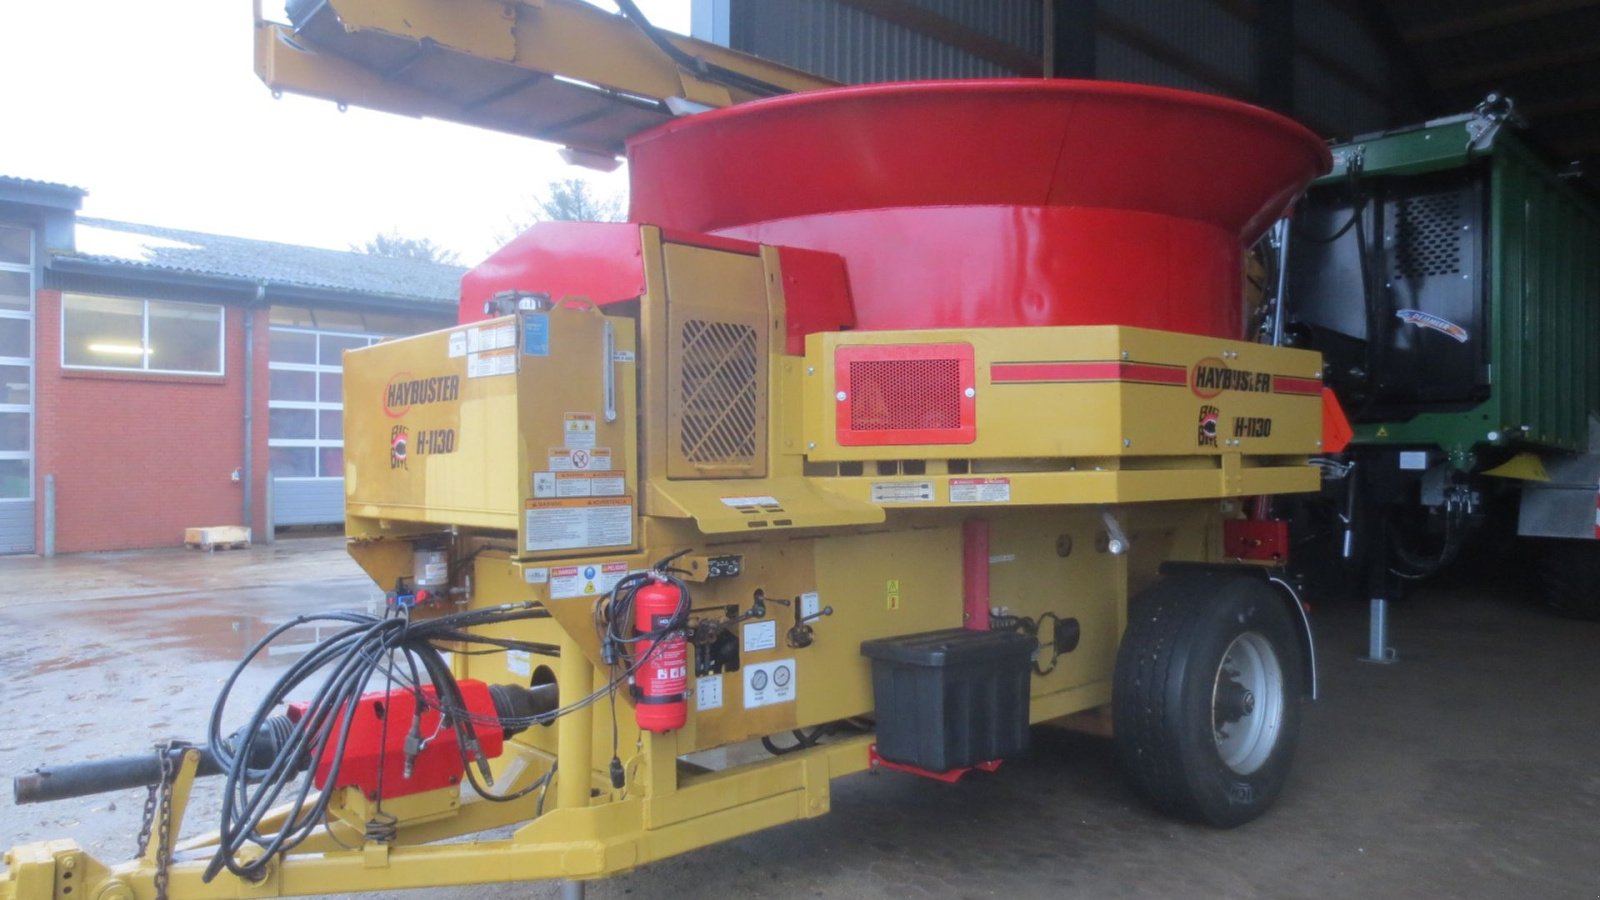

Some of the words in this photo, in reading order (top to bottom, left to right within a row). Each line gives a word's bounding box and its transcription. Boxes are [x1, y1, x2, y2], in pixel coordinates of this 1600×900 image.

[387, 375, 460, 407] HAYBUSTER
[1196, 366, 1271, 392] HAYBUSTER
[1234, 417, 1271, 438] H-1130
[416, 429, 454, 455] H-1130
